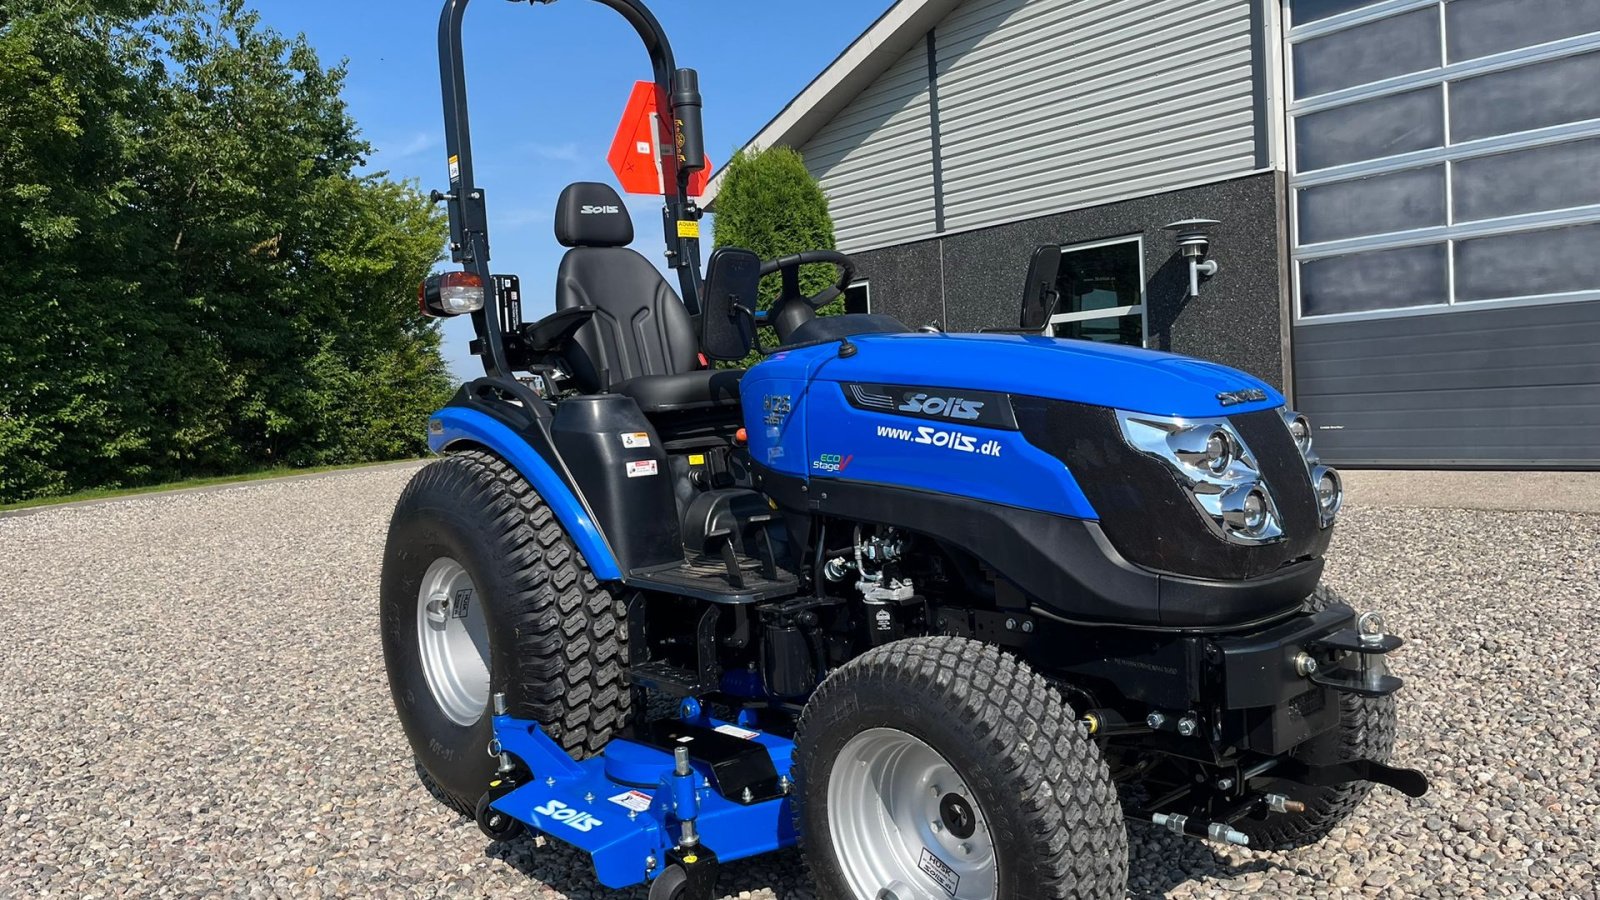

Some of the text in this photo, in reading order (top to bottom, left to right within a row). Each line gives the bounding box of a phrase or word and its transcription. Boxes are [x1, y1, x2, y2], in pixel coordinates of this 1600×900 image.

[820, 453, 841, 463] ECO
[812, 460, 840, 472] Stage
[929, 855, 952, 877] HUSK
